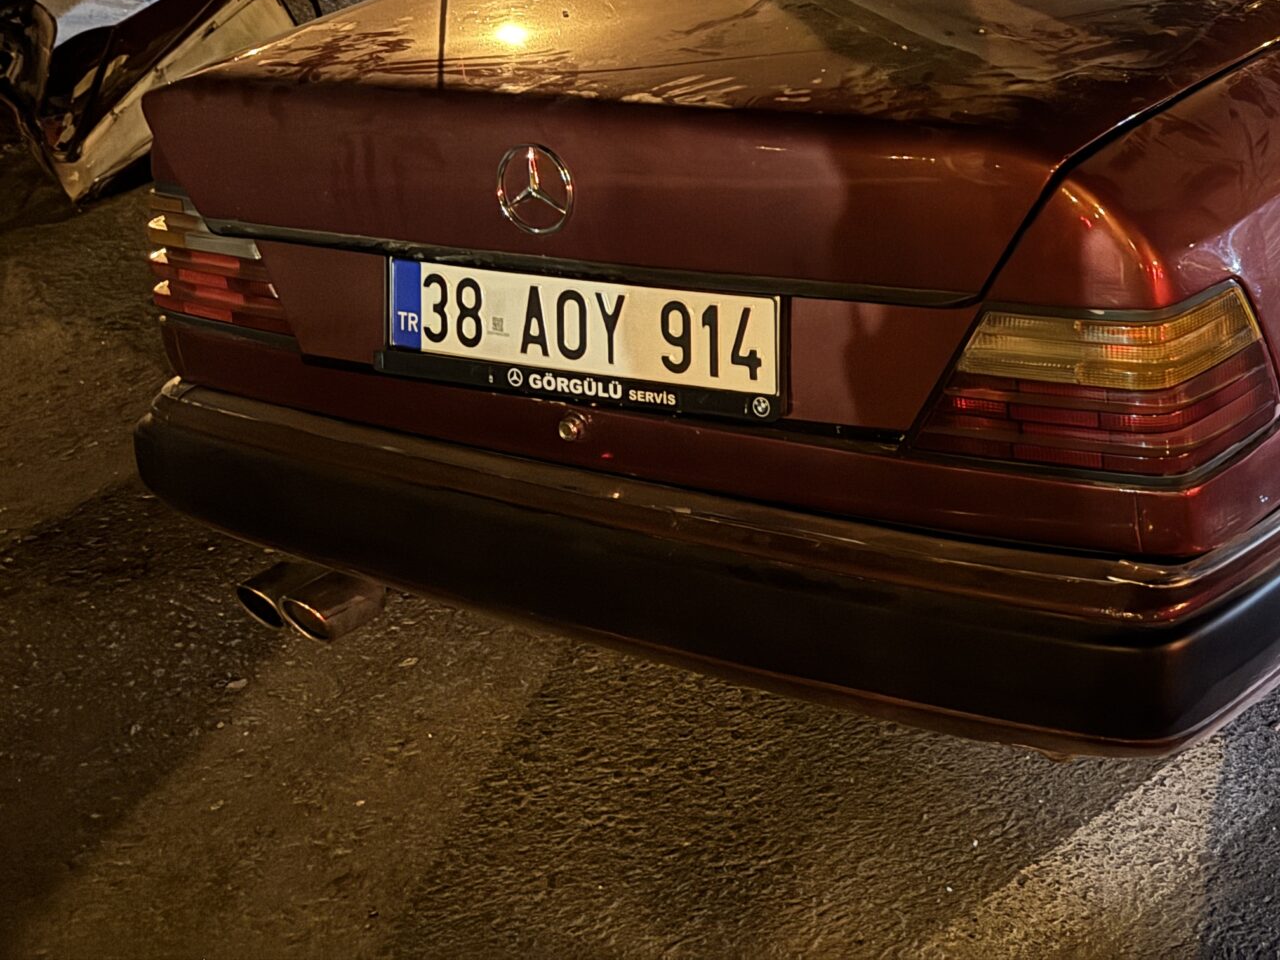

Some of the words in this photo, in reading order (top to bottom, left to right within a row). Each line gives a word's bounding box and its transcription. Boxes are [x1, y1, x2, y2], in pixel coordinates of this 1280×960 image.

[398, 311, 419, 333] TR
[423, 273, 483, 348] 38
[520, 285, 626, 365] AOY
[660, 300, 762, 381] 914
[529, 373, 622, 399] GÖRGÜLÜ
[628, 390, 676, 406] SERVİS
